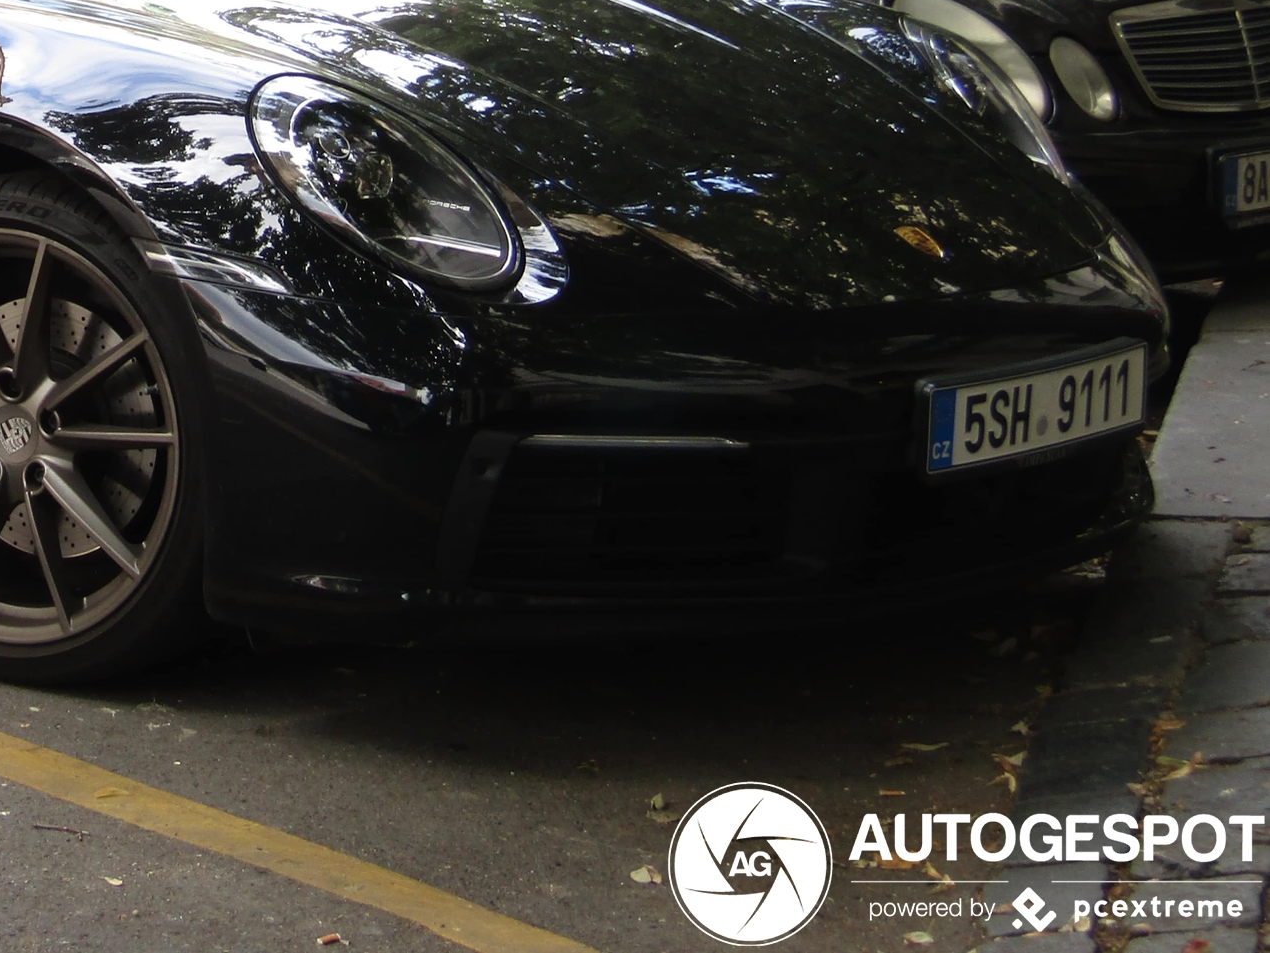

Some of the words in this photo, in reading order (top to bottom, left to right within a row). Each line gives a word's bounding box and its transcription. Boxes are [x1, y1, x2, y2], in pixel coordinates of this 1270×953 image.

[964, 382, 1032, 454] 5SH
[1057, 358, 1130, 434] 9111
[932, 442, 950, 460] CZ
